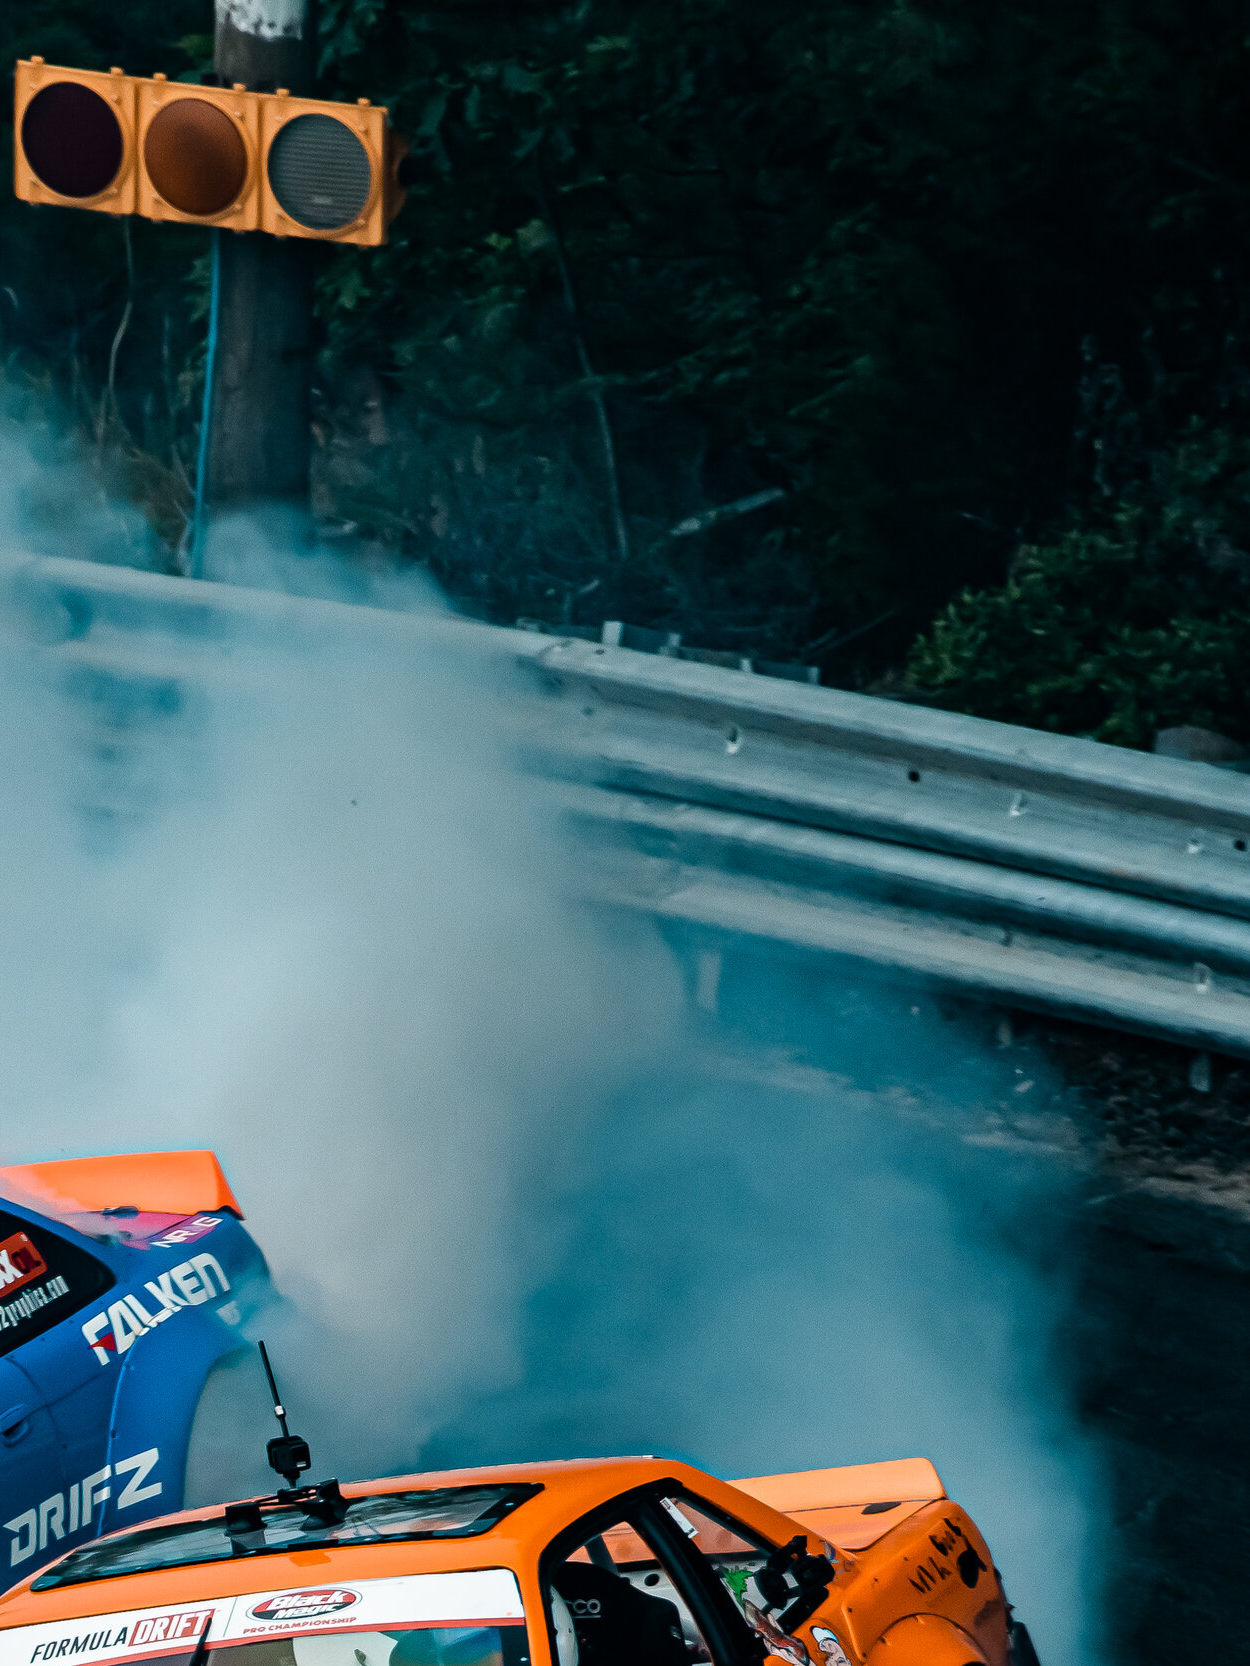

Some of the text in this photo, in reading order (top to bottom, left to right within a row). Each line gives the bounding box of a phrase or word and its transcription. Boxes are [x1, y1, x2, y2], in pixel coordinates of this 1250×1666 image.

[82, 1253, 231, 1366] FALKEN
[3, 1448, 162, 1567] DRIFZ
[267, 1590, 348, 1610] Black
[272, 1602, 344, 1620] Magic
[30, 1609, 215, 1664] FORMULA DRIFT
[243, 1617, 356, 1635] PRO CHAMPIONSHIP
